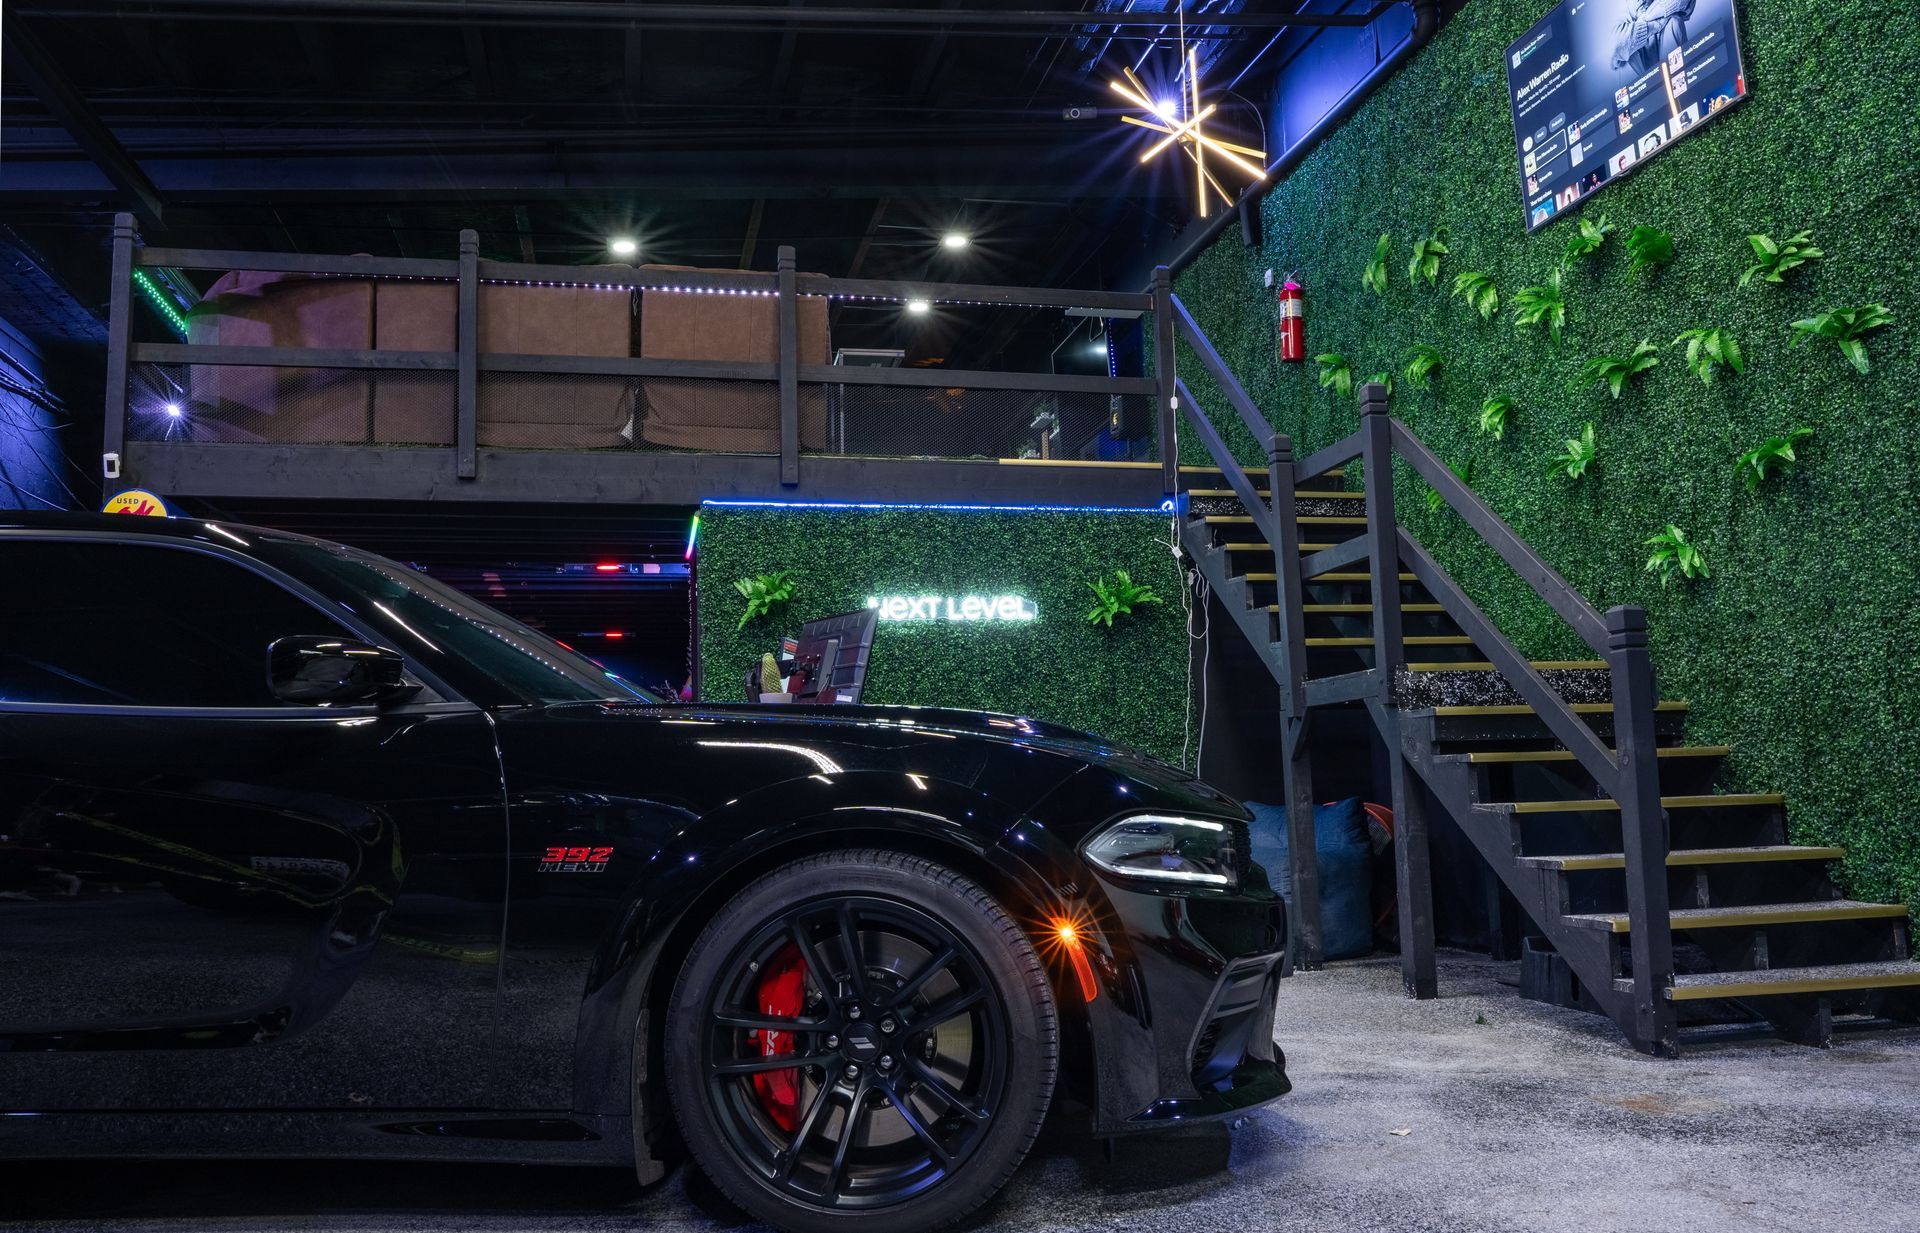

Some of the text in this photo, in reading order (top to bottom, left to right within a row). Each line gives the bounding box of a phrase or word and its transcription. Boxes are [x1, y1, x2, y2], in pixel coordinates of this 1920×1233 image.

[1517, 54, 1569, 101] Alex Warren Radio
[541, 847, 615, 862] 392
[537, 862, 607, 873] HEMI
